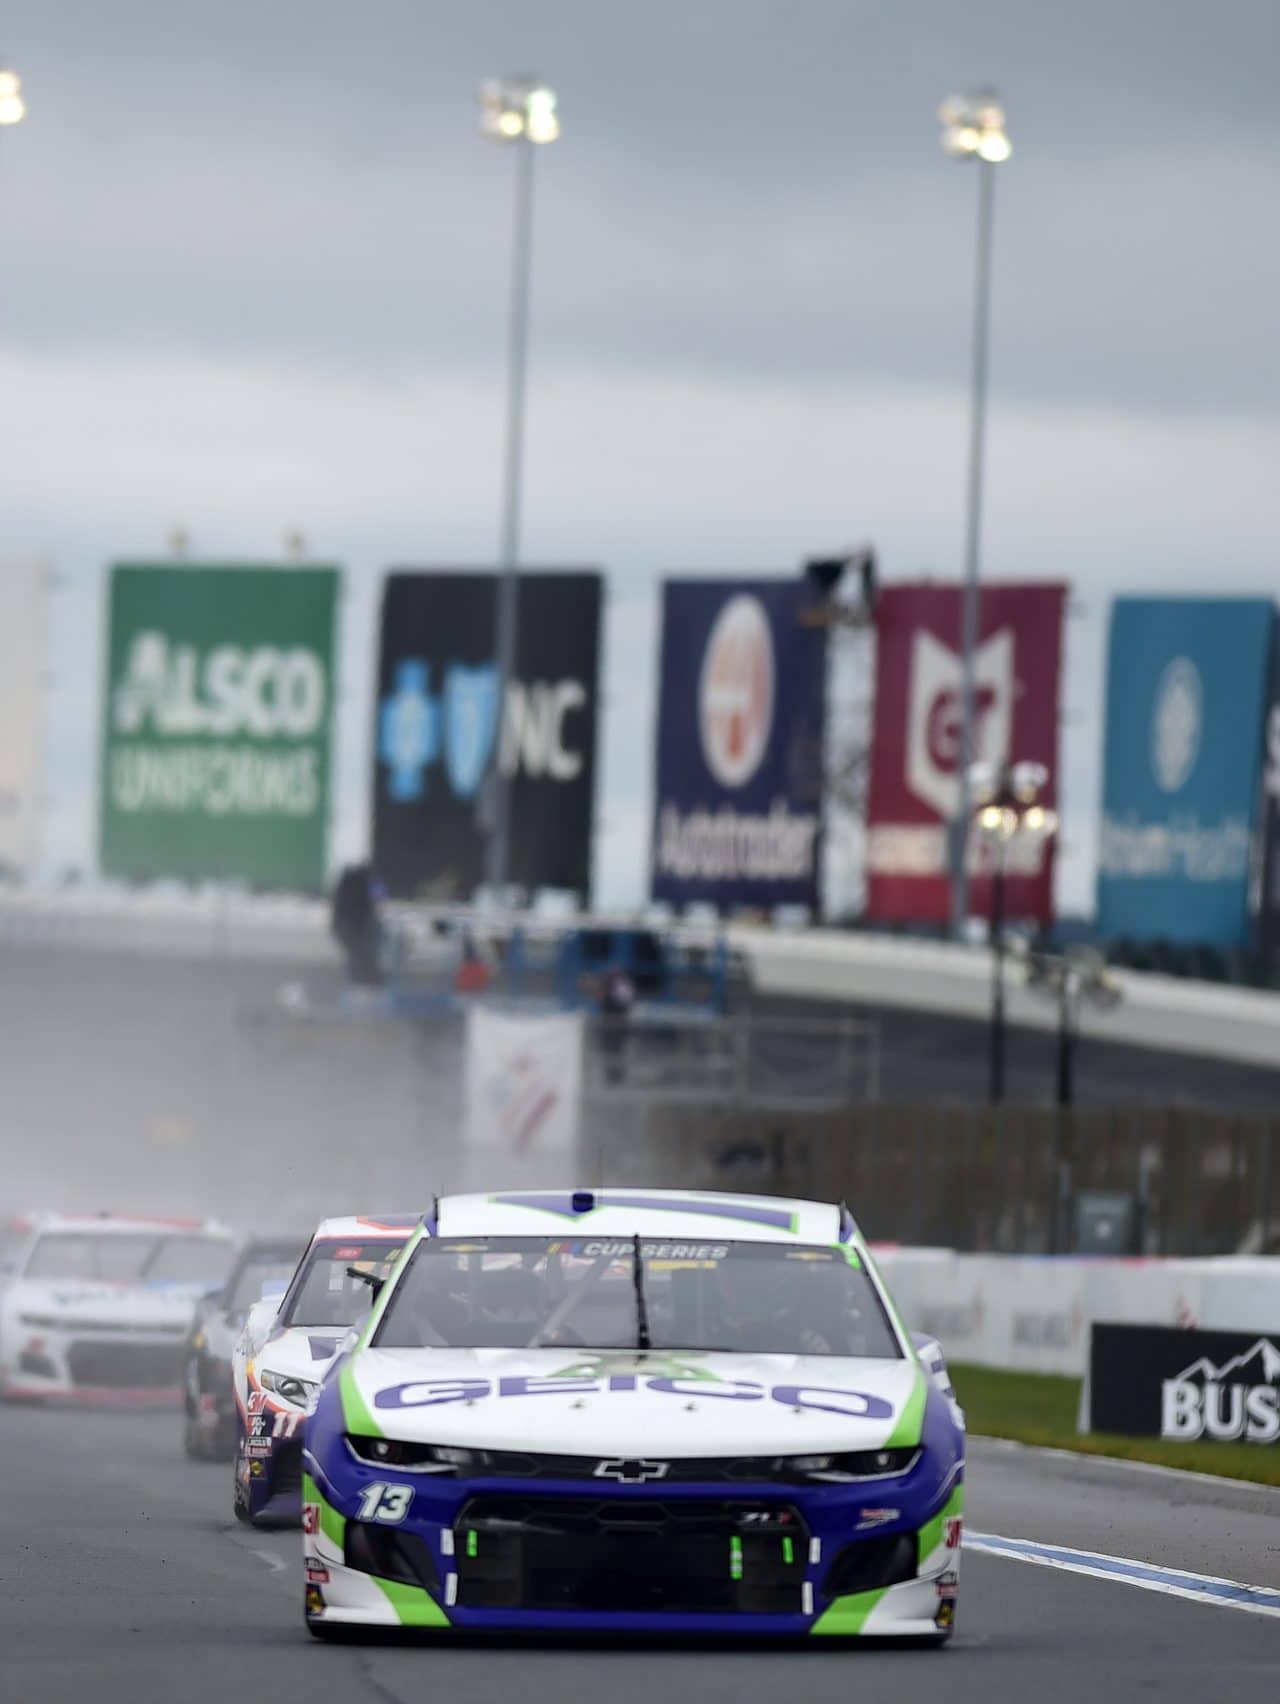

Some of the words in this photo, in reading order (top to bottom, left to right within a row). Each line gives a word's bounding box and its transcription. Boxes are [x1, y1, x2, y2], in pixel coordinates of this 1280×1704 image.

[118, 632, 324, 738] ALSCO
[498, 680, 589, 780] NC
[118, 745, 319, 816] UNIFORMS
[582, 1242, 635, 1256] CUP
[639, 1244, 729, 1260] SERIES
[373, 1376, 893, 1419] GEICO
[272, 1411, 300, 1437] 11
[358, 1481, 415, 1525] 13
